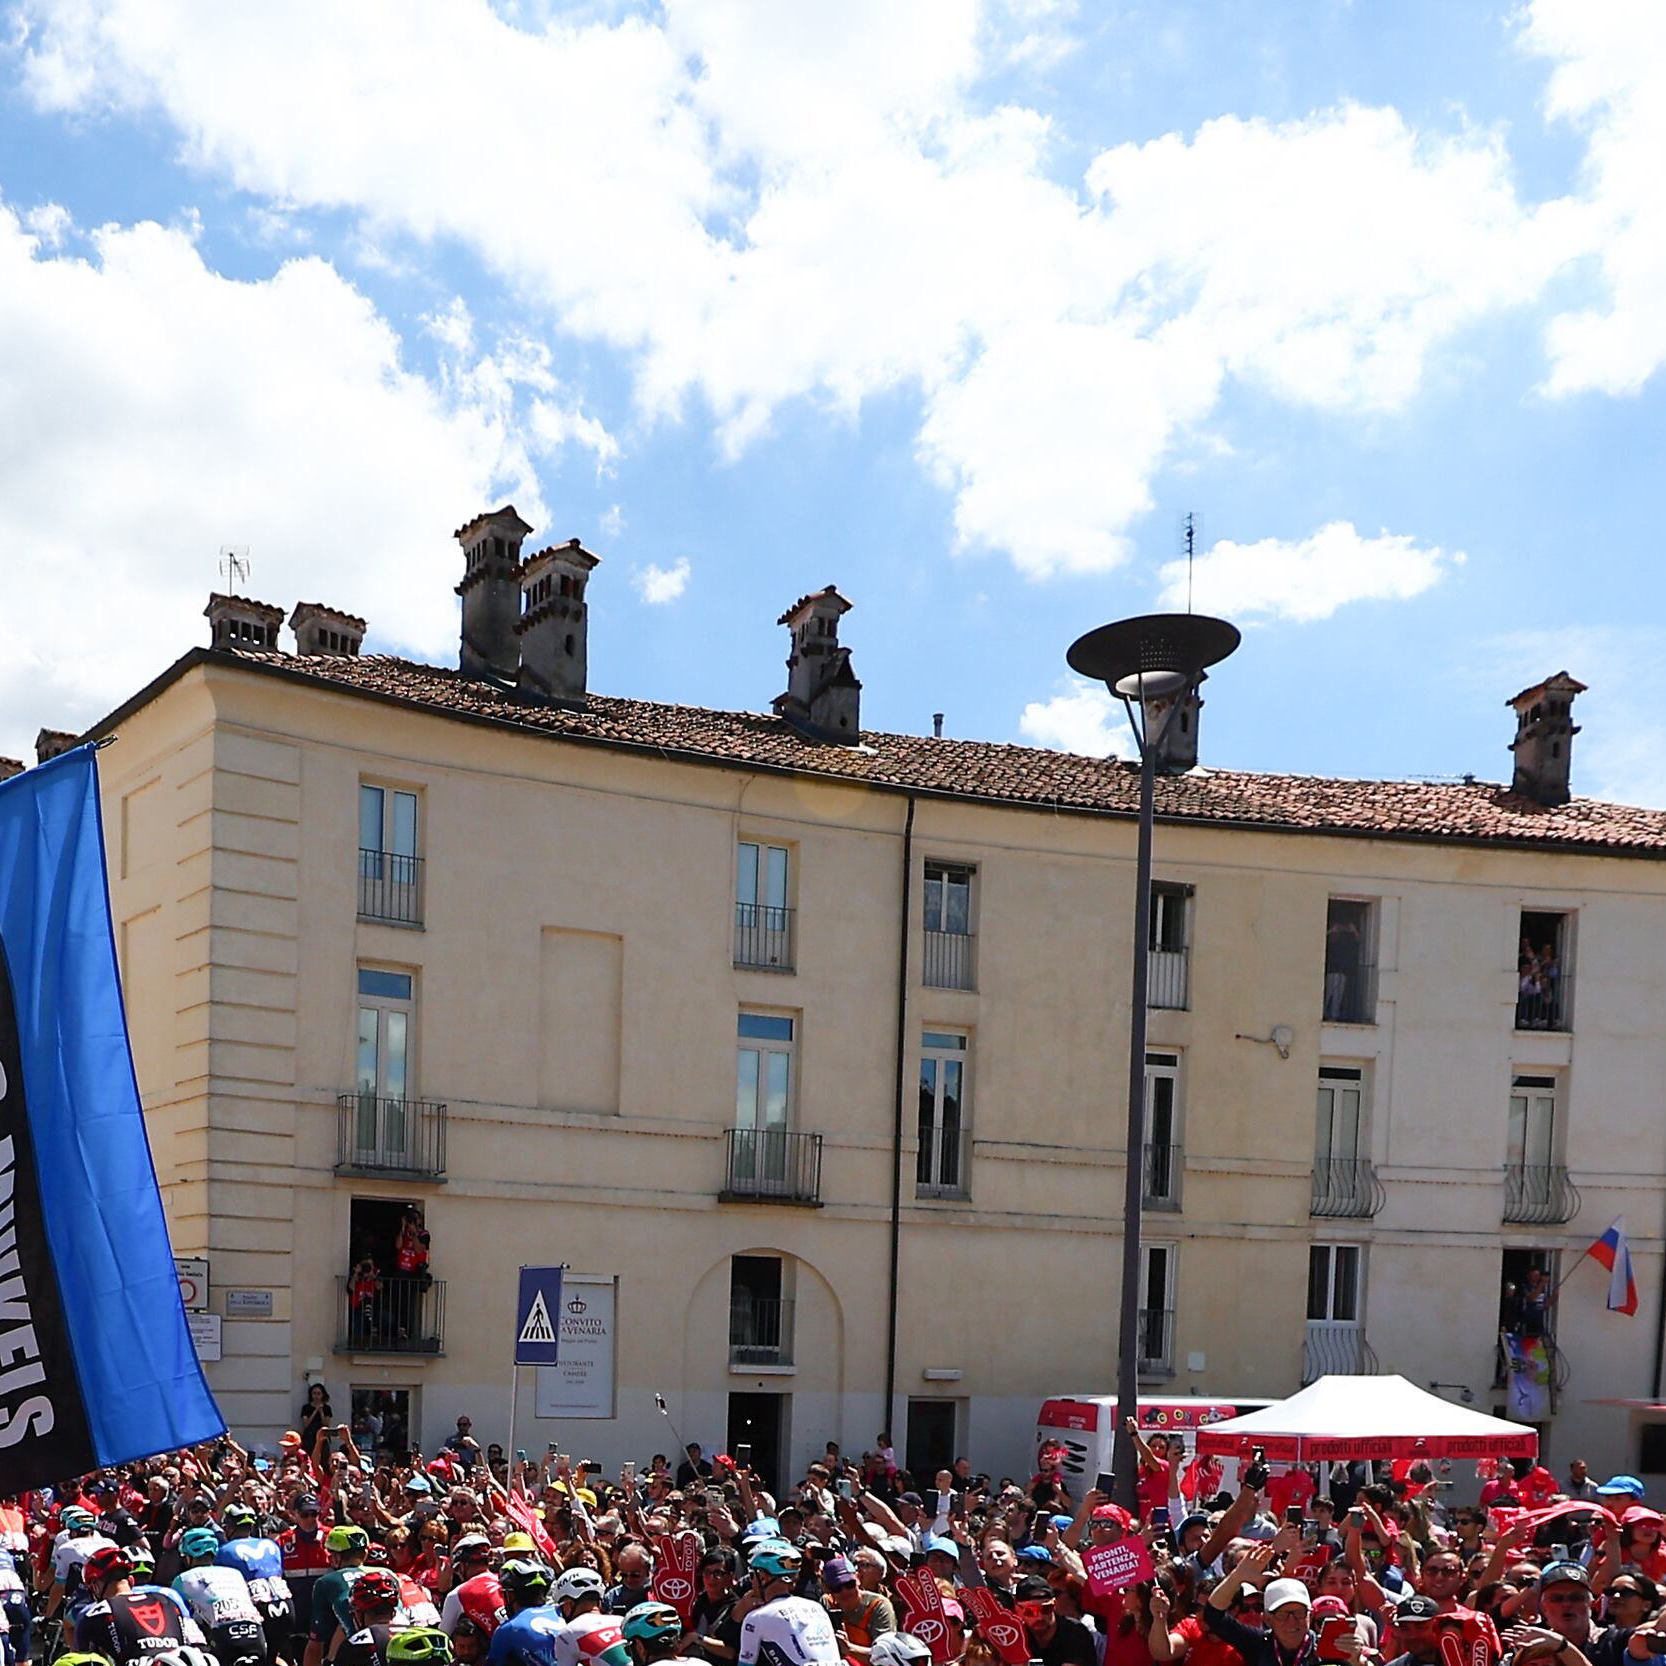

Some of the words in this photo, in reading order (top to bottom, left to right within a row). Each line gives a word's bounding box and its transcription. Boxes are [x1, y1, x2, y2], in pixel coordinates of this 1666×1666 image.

[1309, 1440, 1351, 1458] prodotti
[1446, 1439, 1489, 1455] prodotti
[685, 1539, 693, 1572] TOYOTA
[1094, 1560, 1139, 1580] VENARIA!
[557, 1572, 581, 1590] KASK
[137, 1637, 179, 1650] TUDOR
